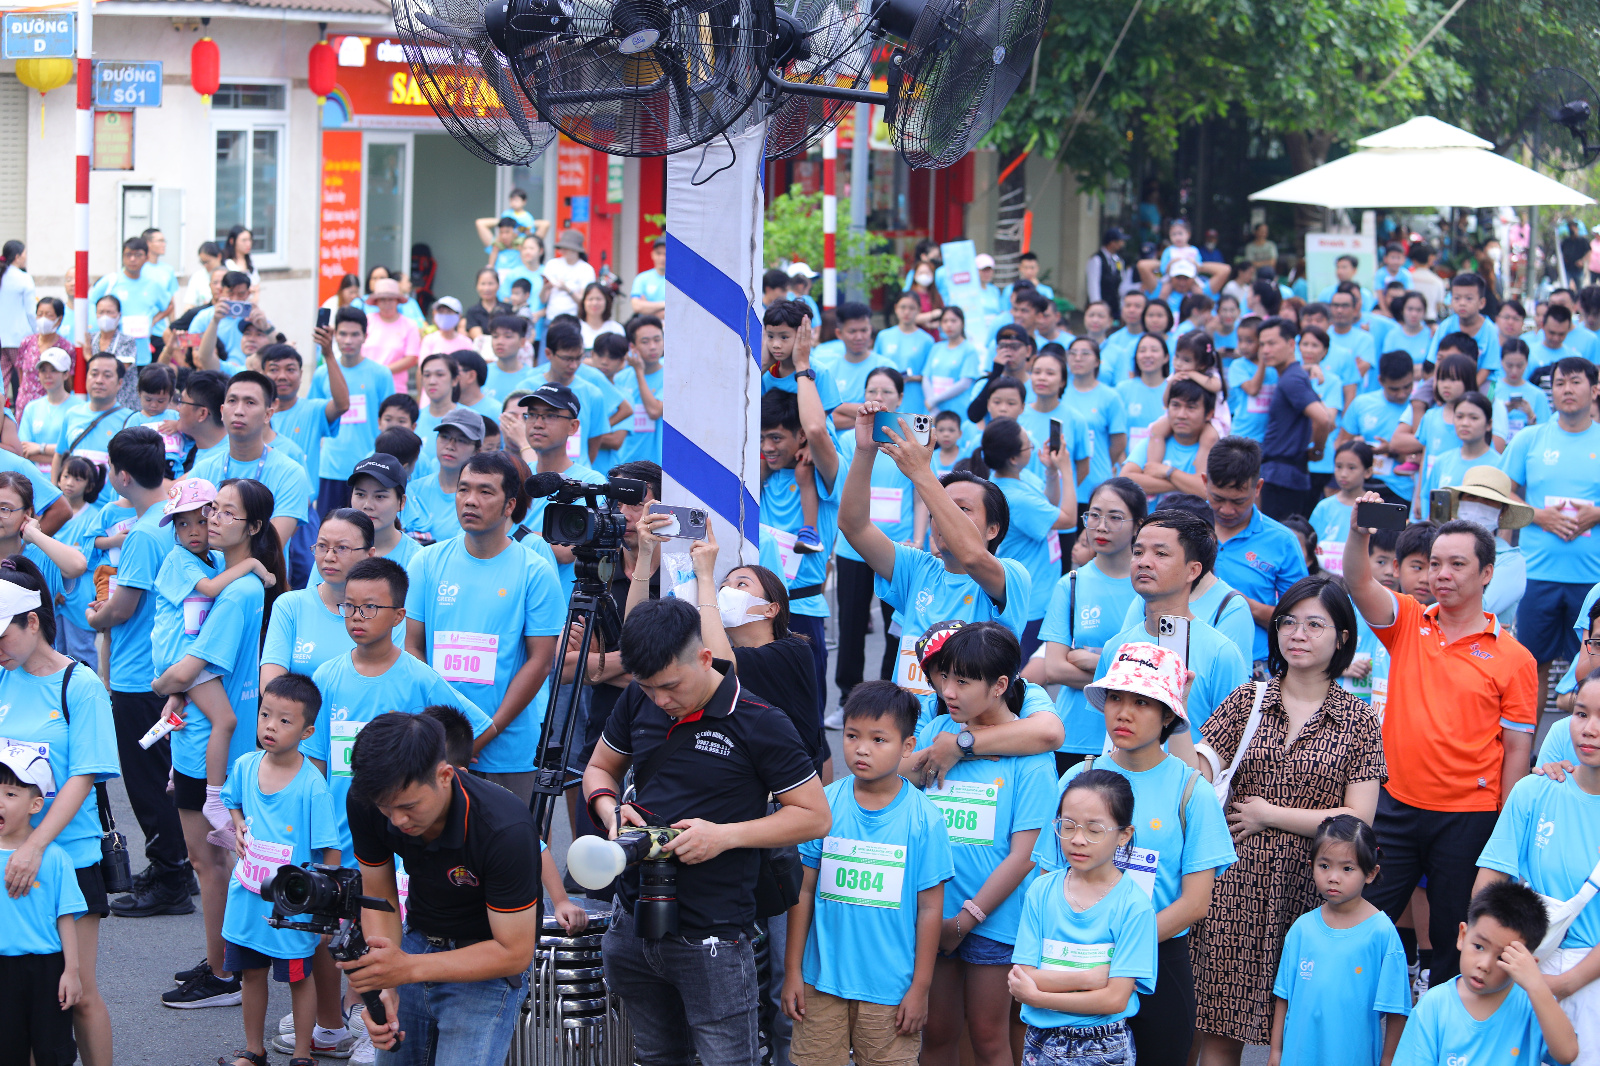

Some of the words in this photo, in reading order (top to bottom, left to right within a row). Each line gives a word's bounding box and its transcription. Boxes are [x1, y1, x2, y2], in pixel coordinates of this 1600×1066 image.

[11, 18, 69, 34] ĐƯỜNG
[34, 39, 46, 52] D
[102, 67, 157, 83] ĐƯỜNG
[1249, 559, 1275, 572] ACT
[1470, 649, 1494, 660] ACT
[443, 653, 481, 673] 0510
[939, 807, 978, 831] 368
[242, 858, 271, 884] 510
[835, 866, 884, 893] 0384
